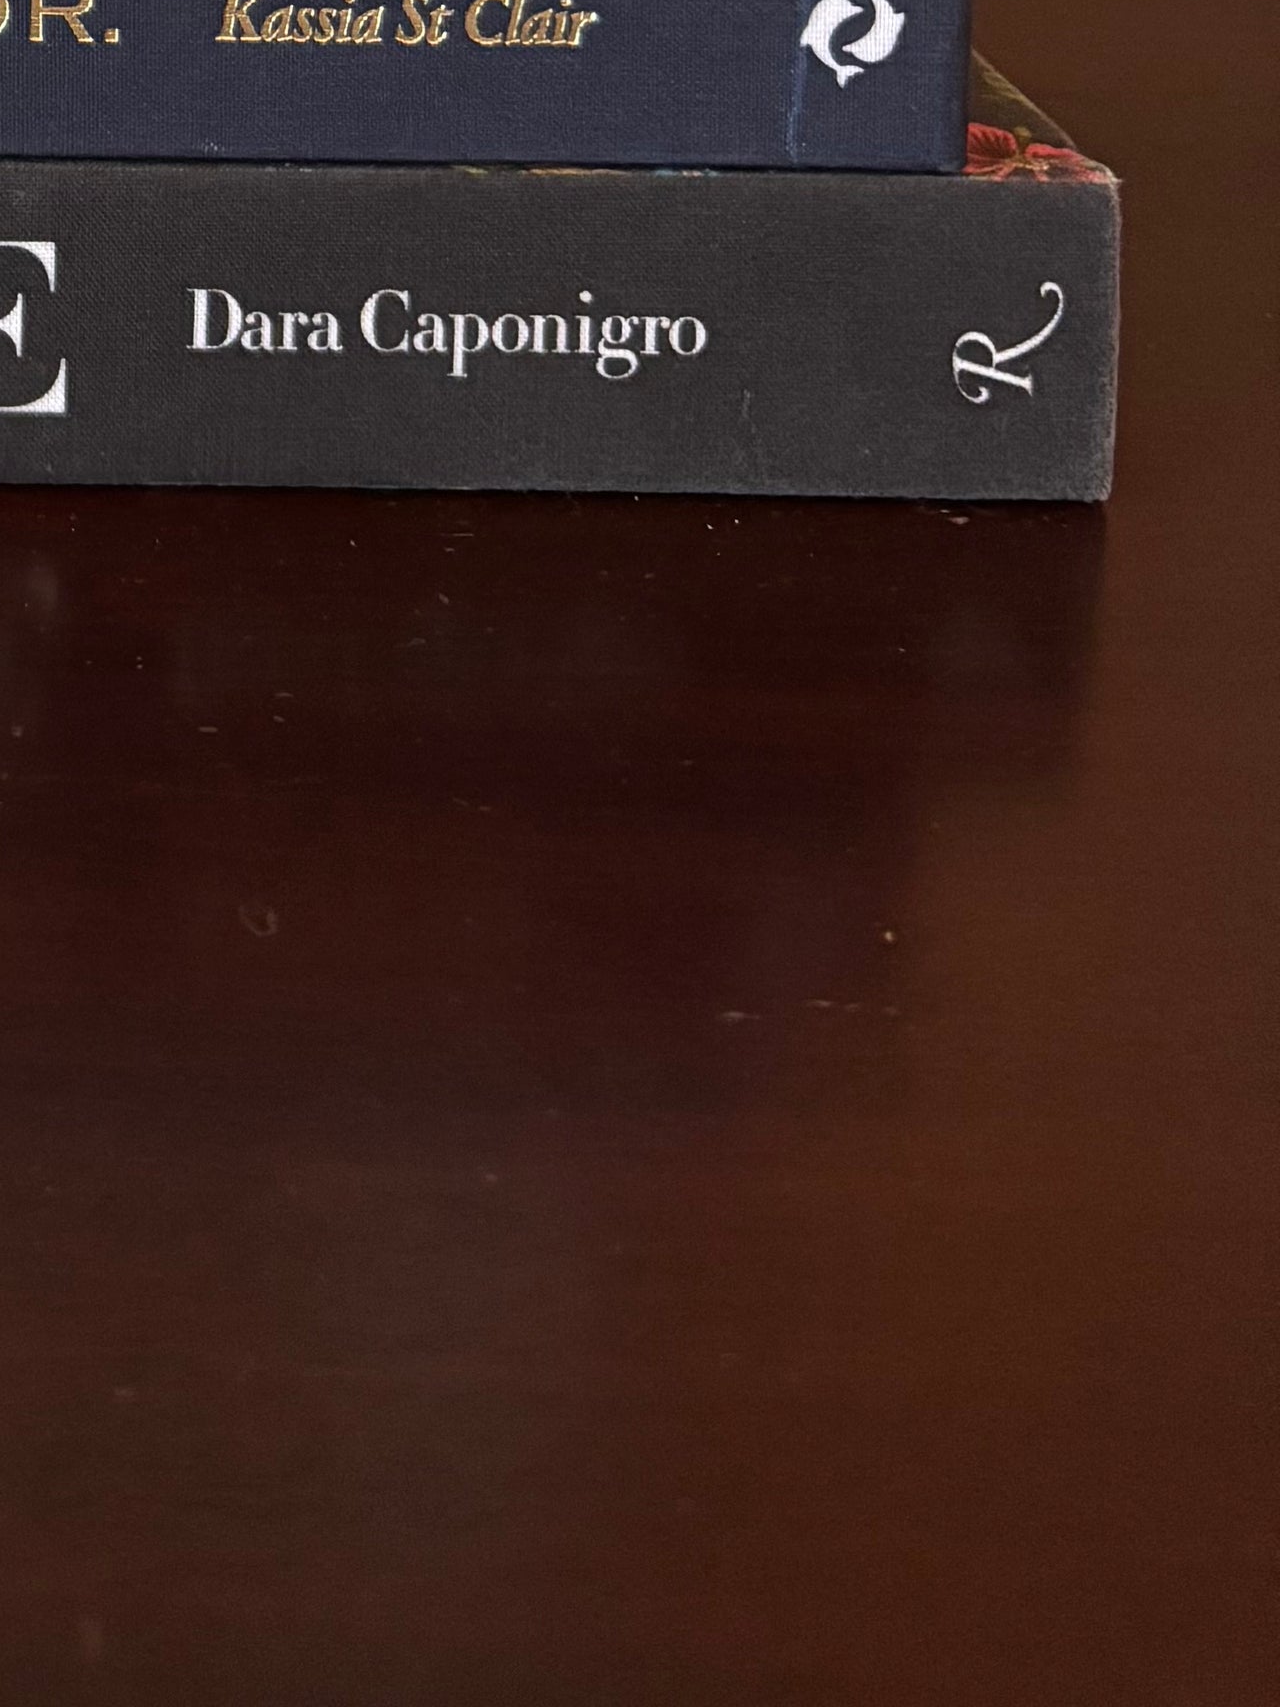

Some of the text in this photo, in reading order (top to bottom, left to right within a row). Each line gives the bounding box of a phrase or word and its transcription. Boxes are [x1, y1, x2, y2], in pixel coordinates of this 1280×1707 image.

[187, 288, 707, 380] Dara Caponigro
[952, 281, 1064, 405] R
